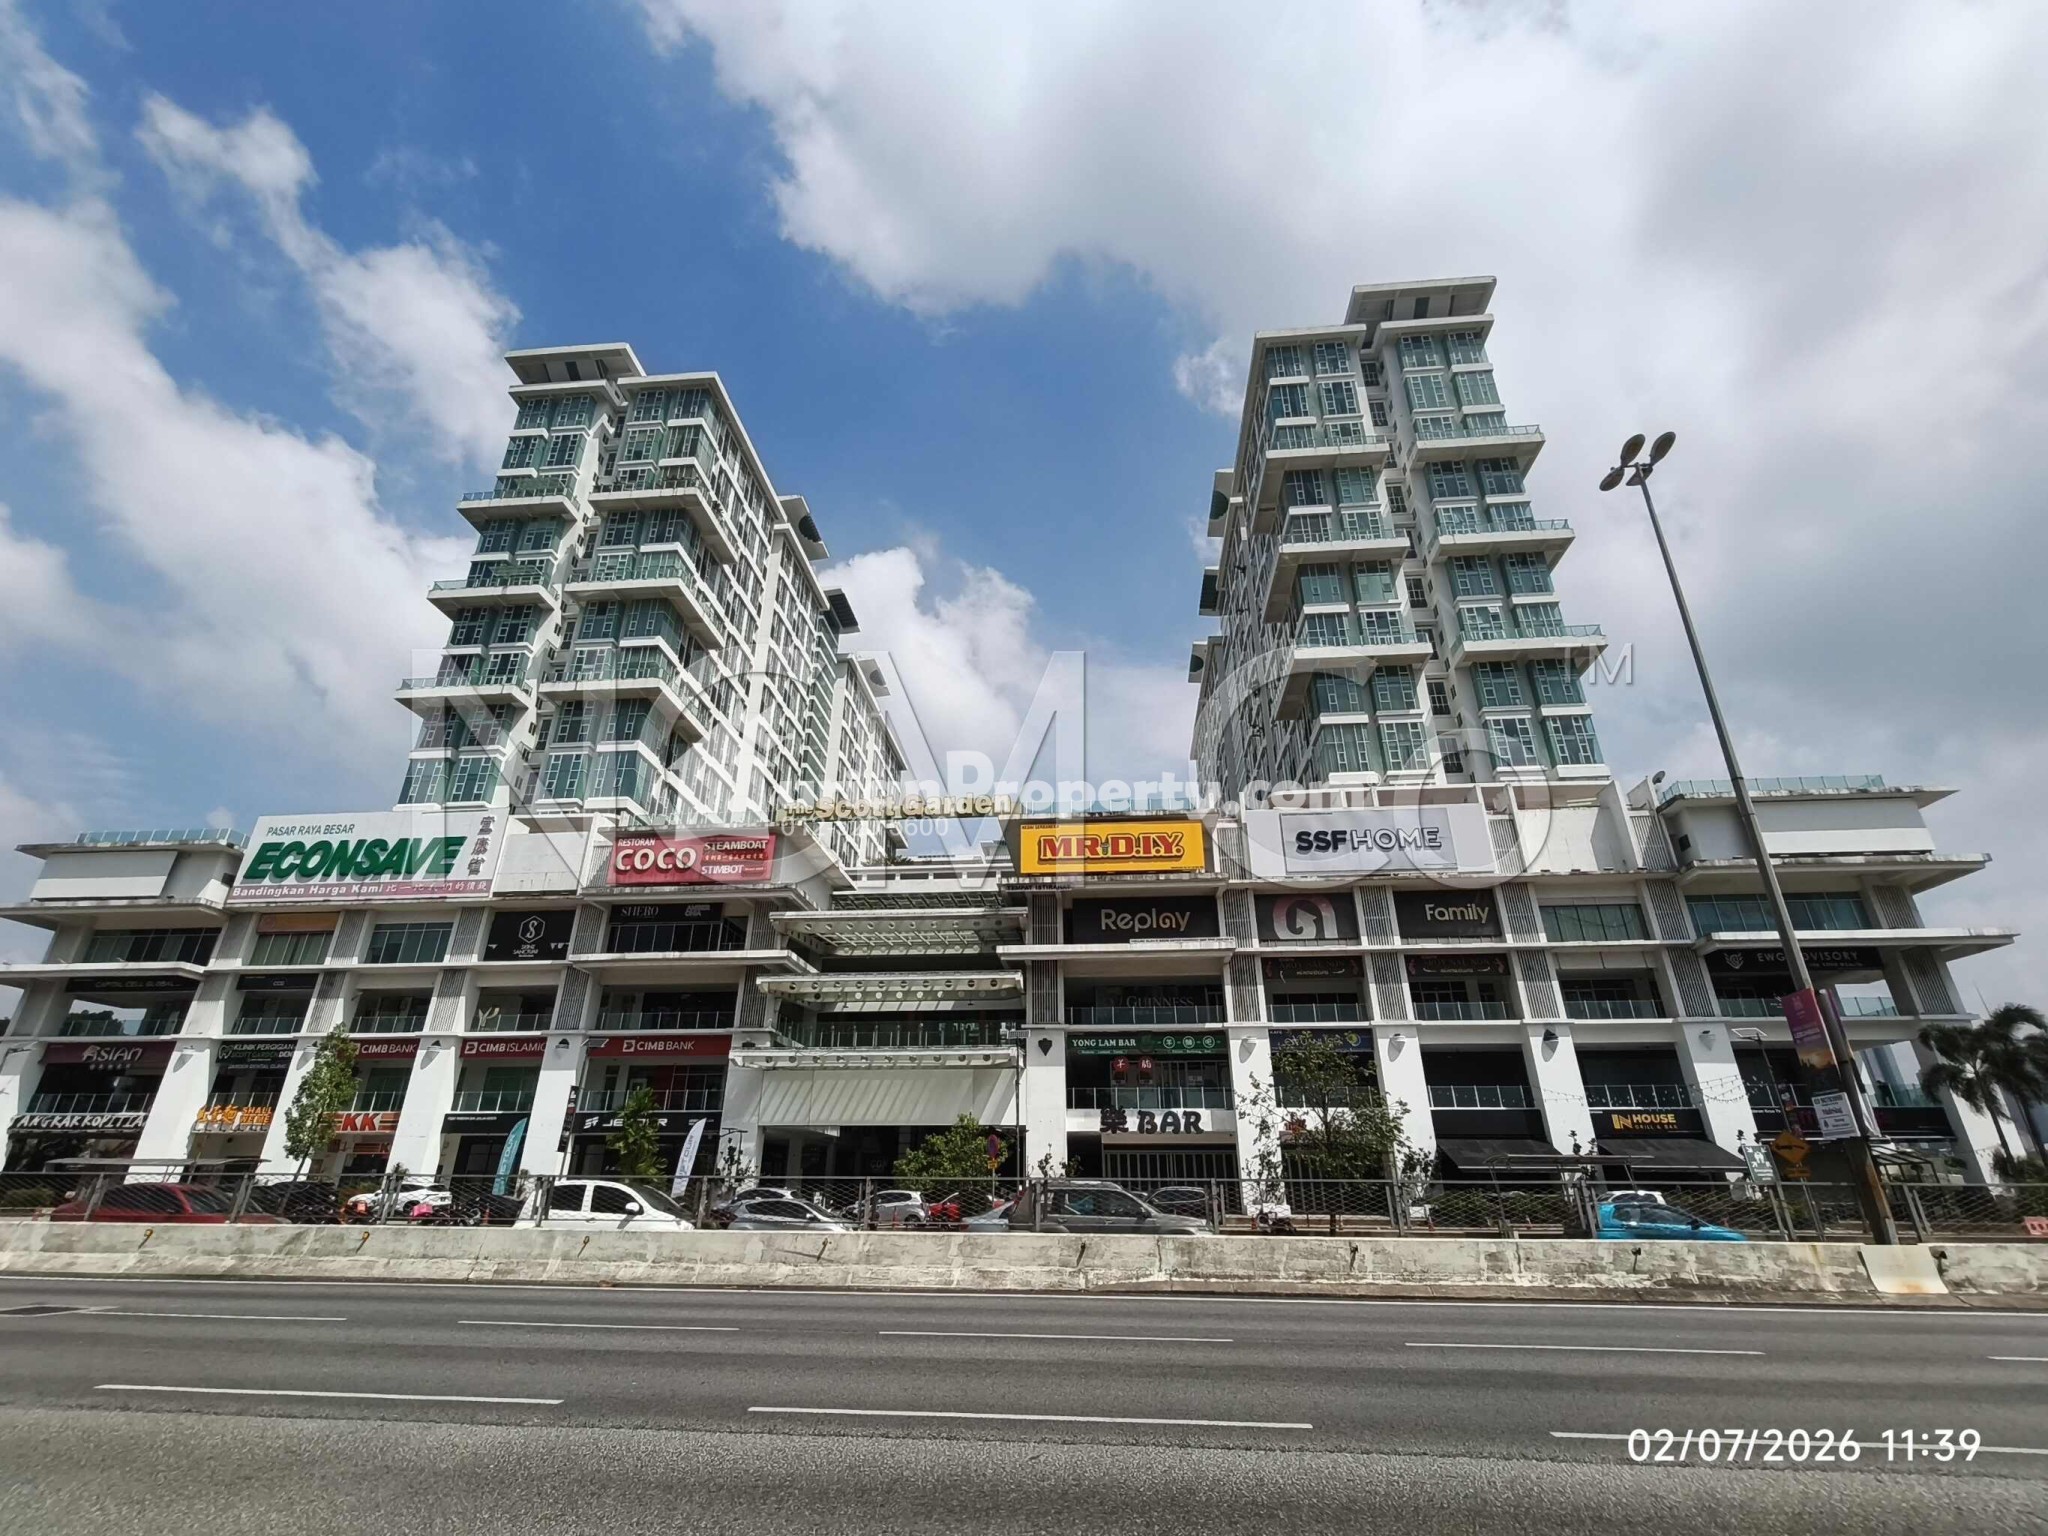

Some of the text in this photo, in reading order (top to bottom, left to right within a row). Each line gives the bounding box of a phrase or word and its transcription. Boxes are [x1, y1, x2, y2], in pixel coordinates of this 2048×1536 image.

[786, 793, 1012, 818] The Scott Garden
[266, 823, 355, 837] PASAR RAYA BESAR
[617, 837, 656, 847] RESTORAN
[703, 839, 769, 851] STEAMBOAT
[1295, 827, 1442, 852] SSF HOME
[242, 836, 468, 881] ECONSAVE
[615, 847, 697, 872] COCO
[700, 864, 745, 875] STIMBOT
[232, 883, 307, 897] Bandingkan
[308, 883, 347, 895] Harga
[350, 882, 383, 894] Kami
[1100, 908, 1191, 933] Replay
[1424, 903, 1489, 924] Family
[1126, 996, 1194, 1009] GUINNESS
[361, 1043, 418, 1054] CIMB BANK
[478, 1041, 547, 1054] CIMB ISLAMIC
[636, 1040, 695, 1052] CIMB BANK
[1071, 1038, 1137, 1047] YONG LAM BAR
[242, 1106, 272, 1114] SHALL
[80, 1114, 147, 1128] KOPITIA
[341, 1112, 381, 1131] KK
[1137, 1110, 1205, 1135] BAR
[1633, 1114, 1677, 1124] HOUSE
